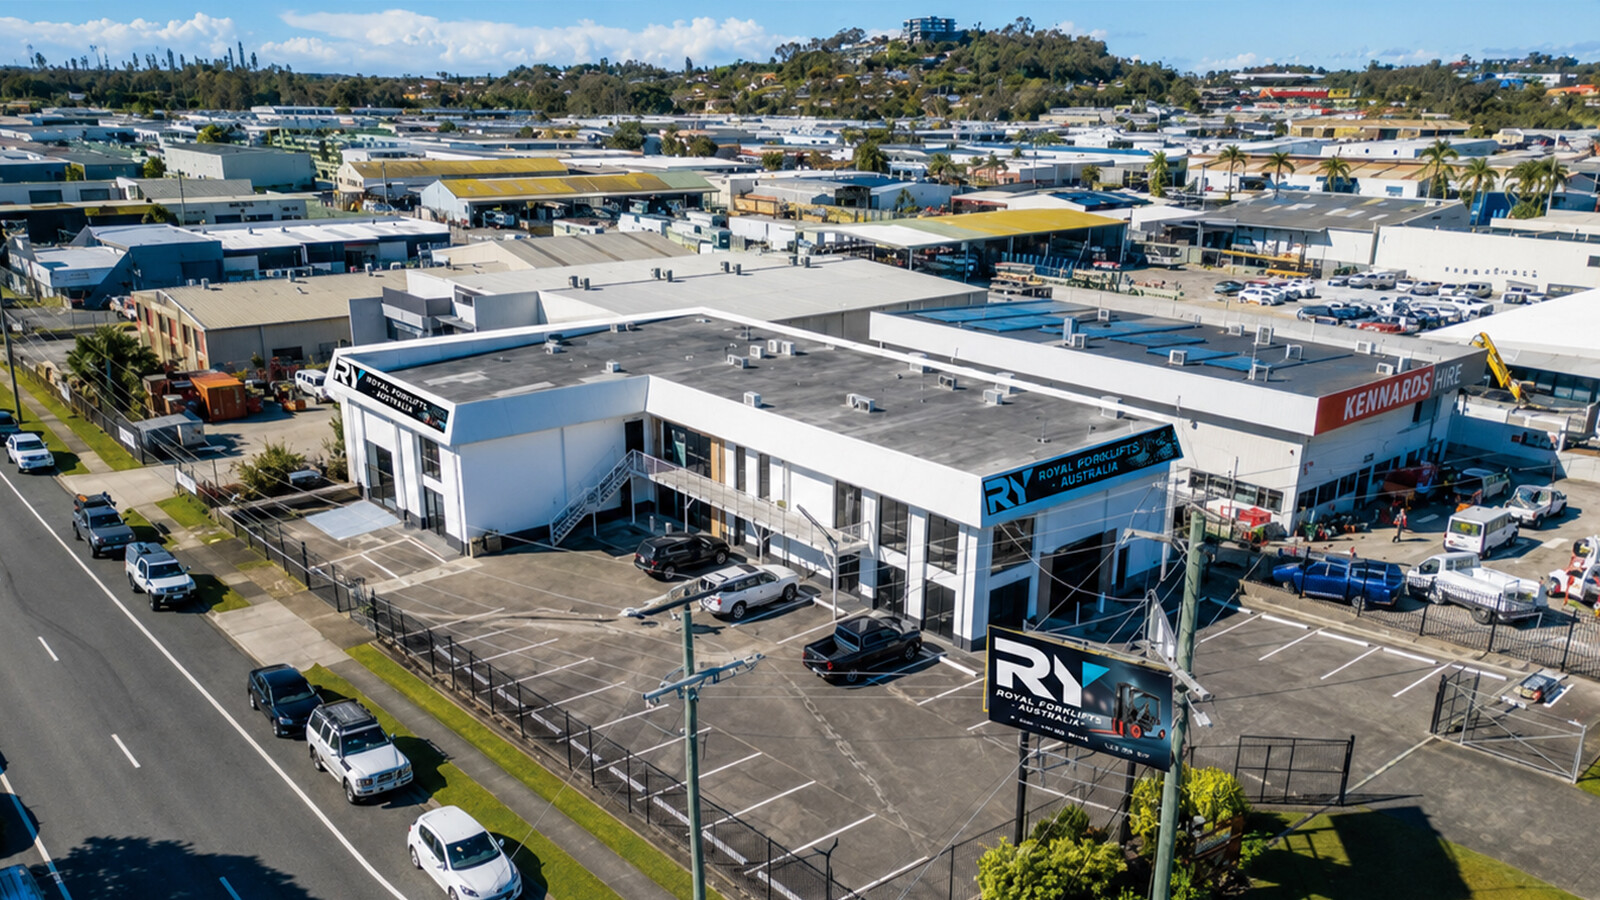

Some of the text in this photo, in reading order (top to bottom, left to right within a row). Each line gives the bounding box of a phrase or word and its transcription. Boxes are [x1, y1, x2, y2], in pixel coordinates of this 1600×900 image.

[334, 360, 366, 390] RY
[1343, 363, 1463, 421] KENNARDS HIRE
[1038, 441, 1140, 481] ROYAL FORKLIFTS
[1060, 461, 1119, 488] AUSTRALIA
[985, 468, 1034, 514] RY
[994, 636, 1111, 708] RY
[996, 689, 1102, 725] ROYAL FORKLIFTS
